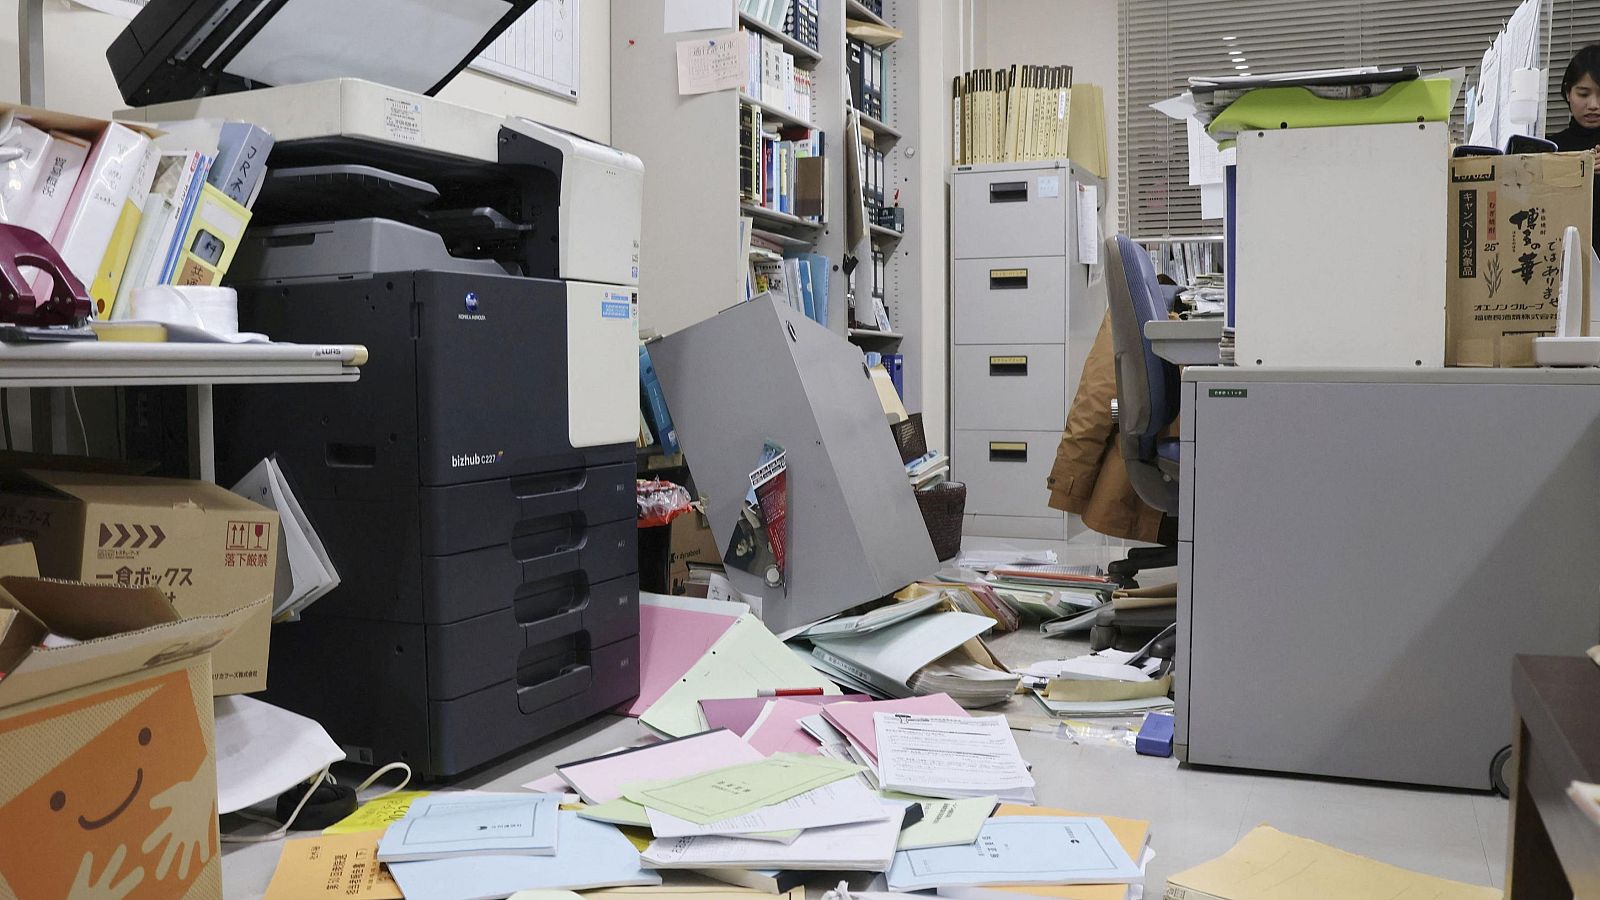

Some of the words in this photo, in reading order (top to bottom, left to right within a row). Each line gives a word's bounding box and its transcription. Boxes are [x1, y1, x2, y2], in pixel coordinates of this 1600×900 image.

[1463, 192, 1473, 276] キャンペーン対象品
[1508, 207, 1543, 285] 博多の華
[451, 452, 481, 467] bizhub
[225, 553, 269, 568] 落下厳禁
[96, 566, 193, 587] 一食ボックス
